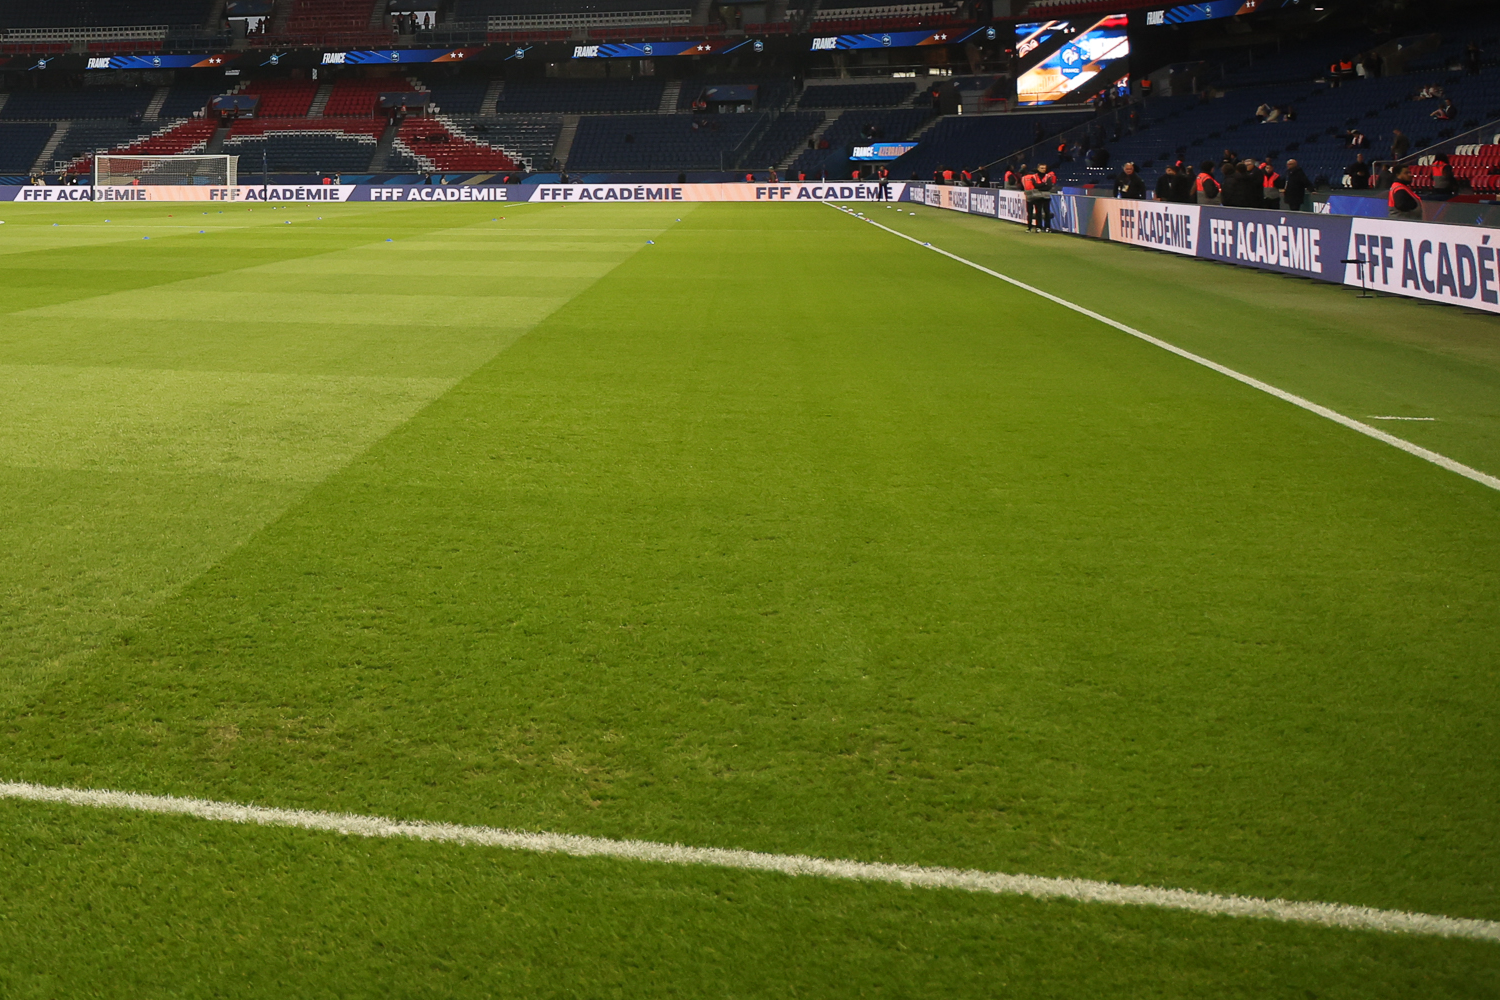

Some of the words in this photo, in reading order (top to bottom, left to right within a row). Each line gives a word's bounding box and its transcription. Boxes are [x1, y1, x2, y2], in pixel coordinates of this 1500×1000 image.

[812, 37, 837, 49] FRANCE
[322, 53, 346, 63] FRANCE
[573, 46, 599, 57] FRANCE
[87, 57, 110, 68] FRANCE
[23, 189, 52, 200] FFF
[245, 186, 339, 200] ACADÉMIE
[370, 188, 403, 200] FFF
[407, 186, 507, 200] ACADÉMIE
[540, 188, 573, 200] FFF
[578, 185, 682, 200] ACADÉMIE
[756, 187, 791, 199] FFF
[1120, 208, 1134, 239] FFF
[1137, 207, 1192, 250] ACADÉMIE
[1210, 218, 1234, 258] FFF
[1236, 217, 1323, 273] ACADÉMIE
[1354, 233, 1393, 285] FFF
[1401, 235, 1500, 305] ACADÉ
